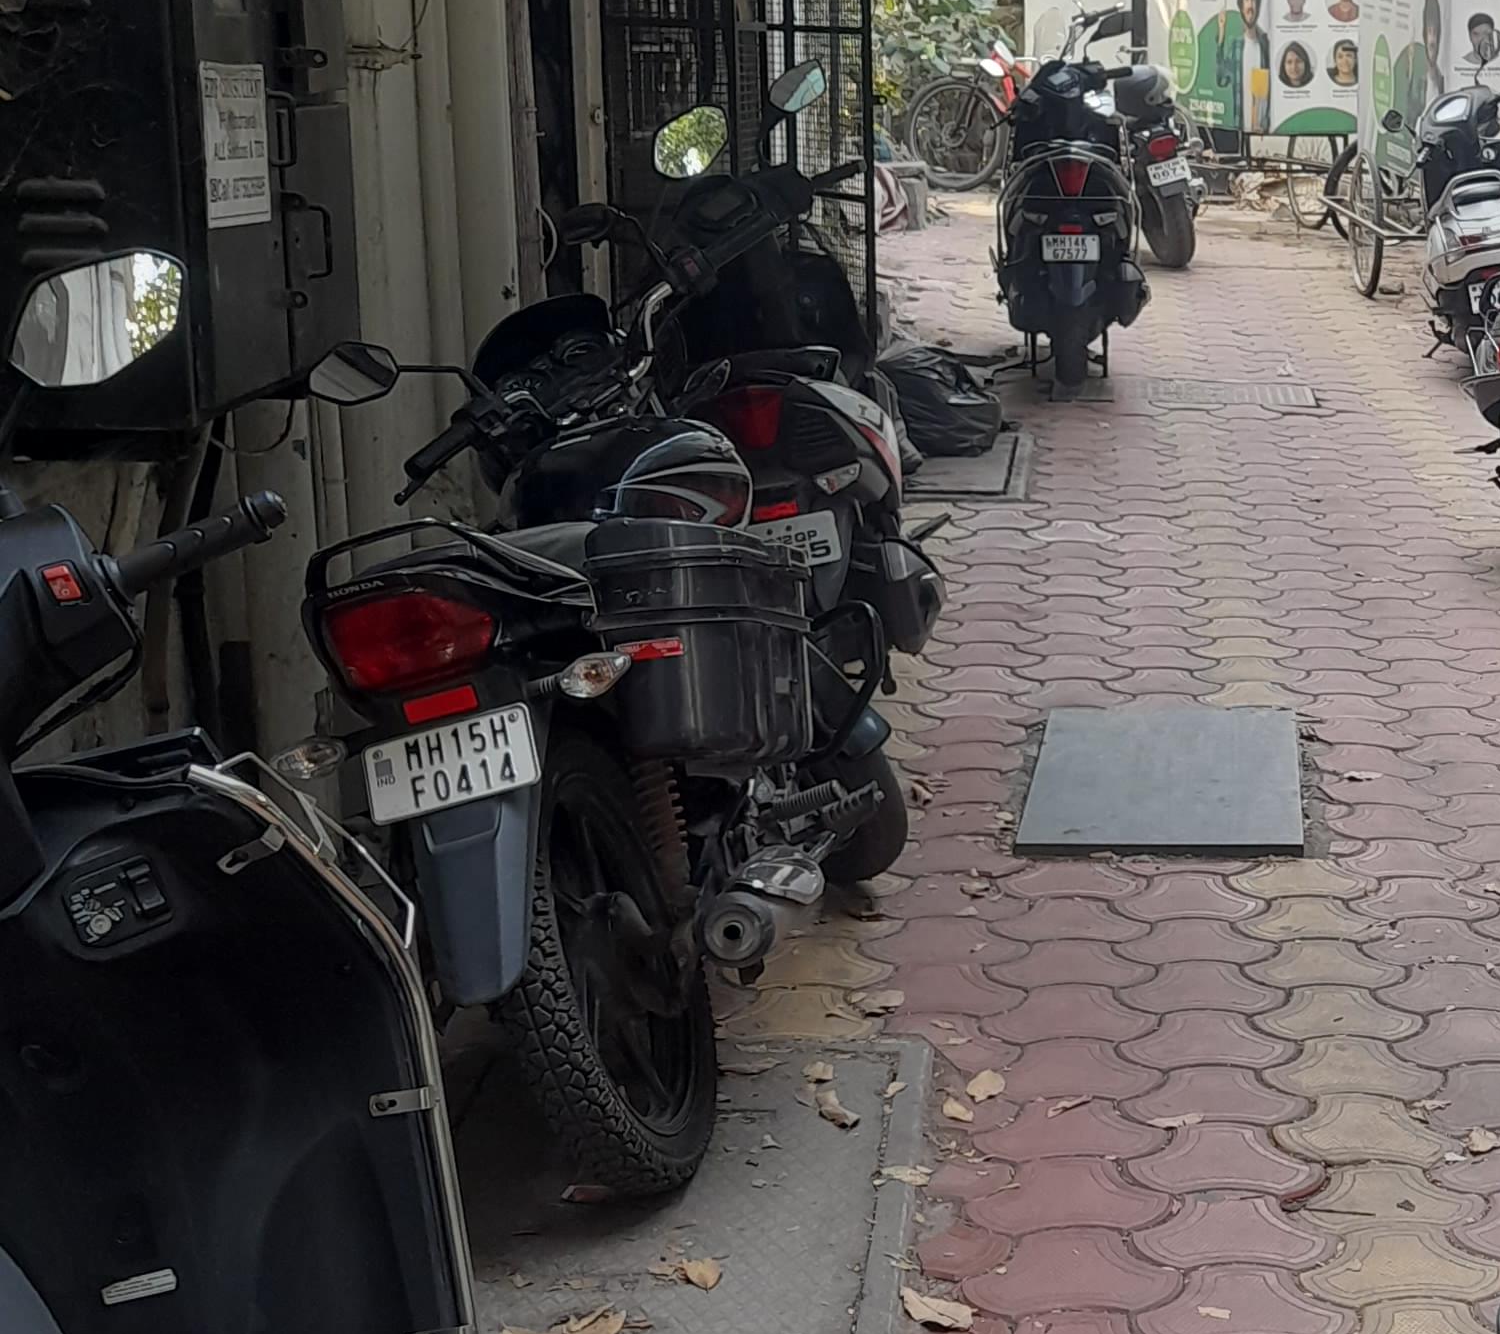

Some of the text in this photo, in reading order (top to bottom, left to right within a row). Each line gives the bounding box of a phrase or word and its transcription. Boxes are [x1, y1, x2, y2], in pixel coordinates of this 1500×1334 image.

[327, 580, 385, 599] HONDA
[404, 714, 511, 772] MH15H
[376, 775, 396, 788] IND
[410, 752, 516, 809] F0414
